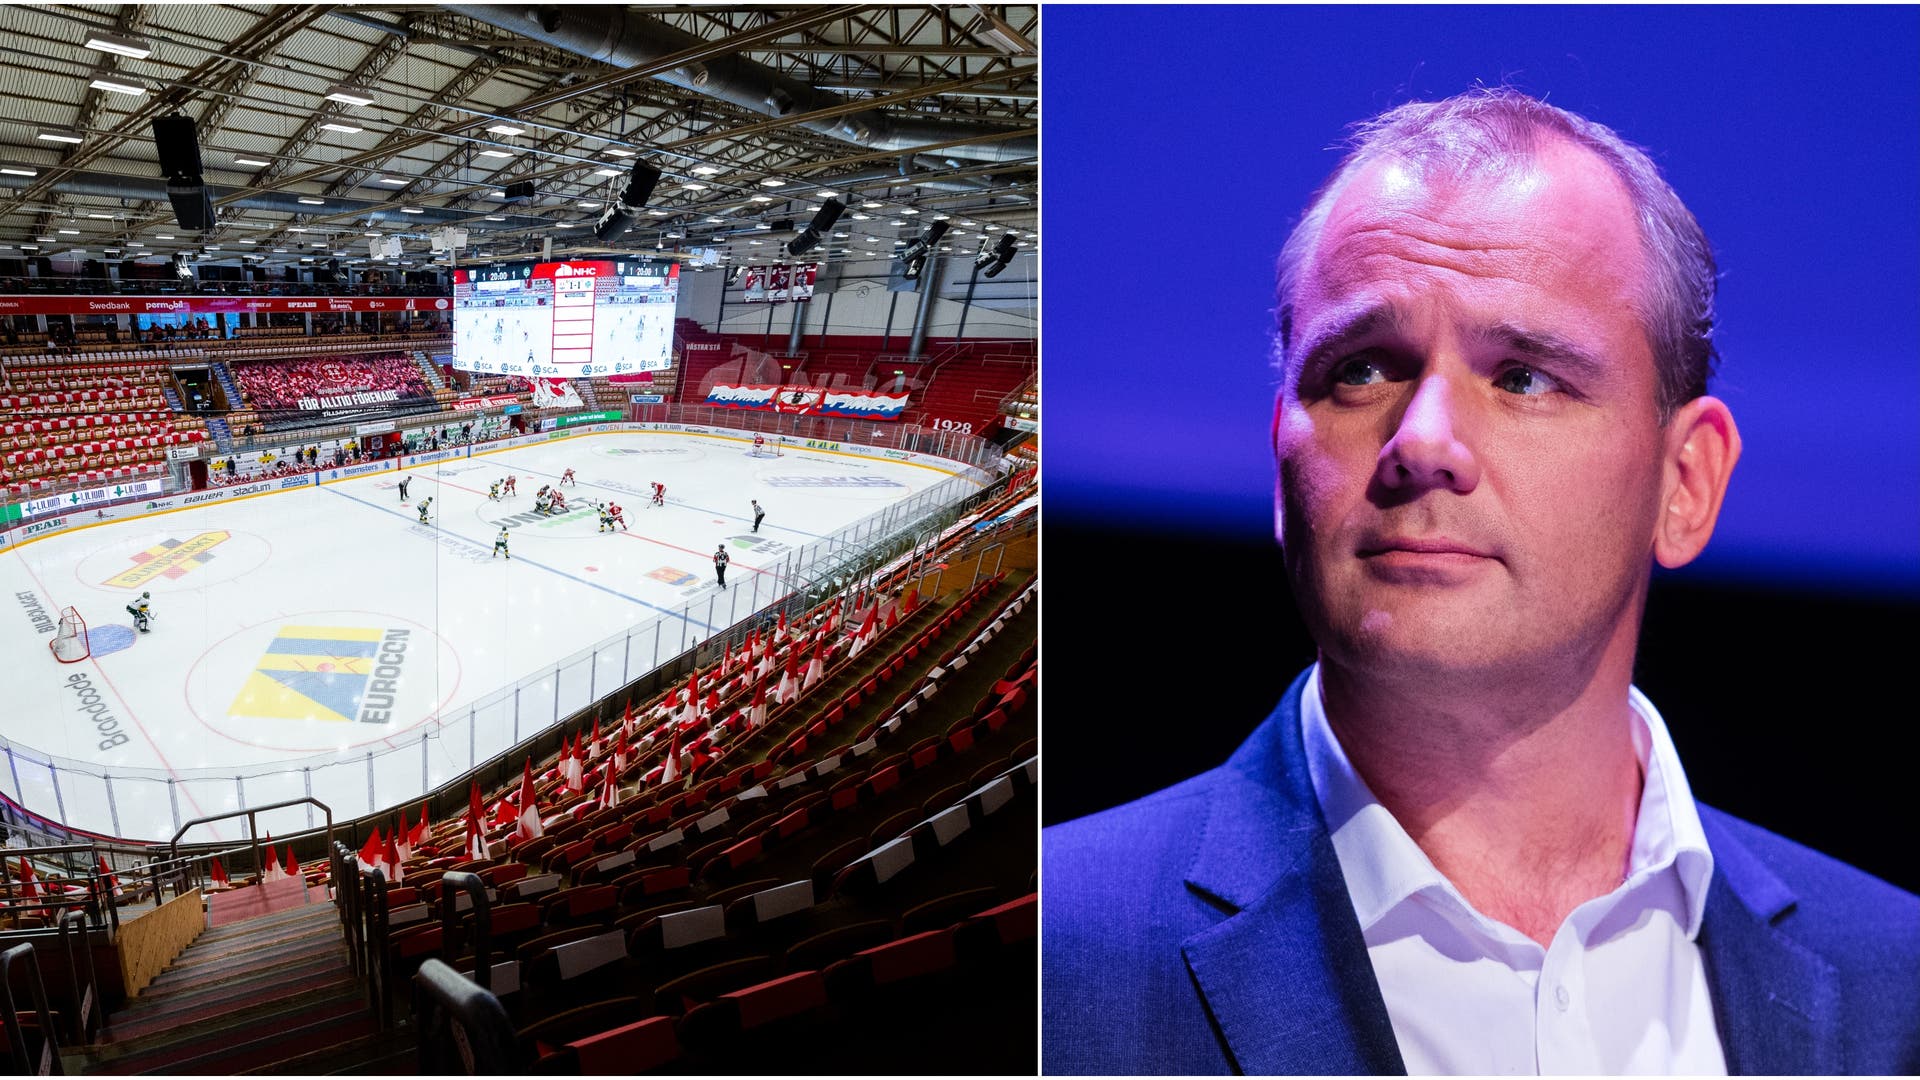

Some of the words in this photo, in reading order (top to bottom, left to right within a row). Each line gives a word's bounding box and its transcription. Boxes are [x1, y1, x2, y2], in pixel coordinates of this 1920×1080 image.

[490, 271, 507, 281] 20:00
[512, 270, 516, 279] 1
[573, 267, 596, 275] NHC
[636, 267, 651, 276] 20:00
[89, 301, 130, 309] Swedbank
[146, 300, 184, 310] permobil
[298, 396, 320, 410] FÖR
[320, 395, 352, 409] ALLTID
[351, 389, 399, 405] FÖRENADE
[595, 424, 620, 432] ADVEN
[932, 417, 972, 435] 1928
[421, 451, 450, 462] teamsters
[343, 463, 379, 476] teamsters
[281, 474, 309, 483] JOWIC
[233, 482, 271, 497] stadium
[27, 519, 63, 534] PEAB
[360, 628, 411, 725] EUROCON
[64, 672, 130, 751] Brandcode
